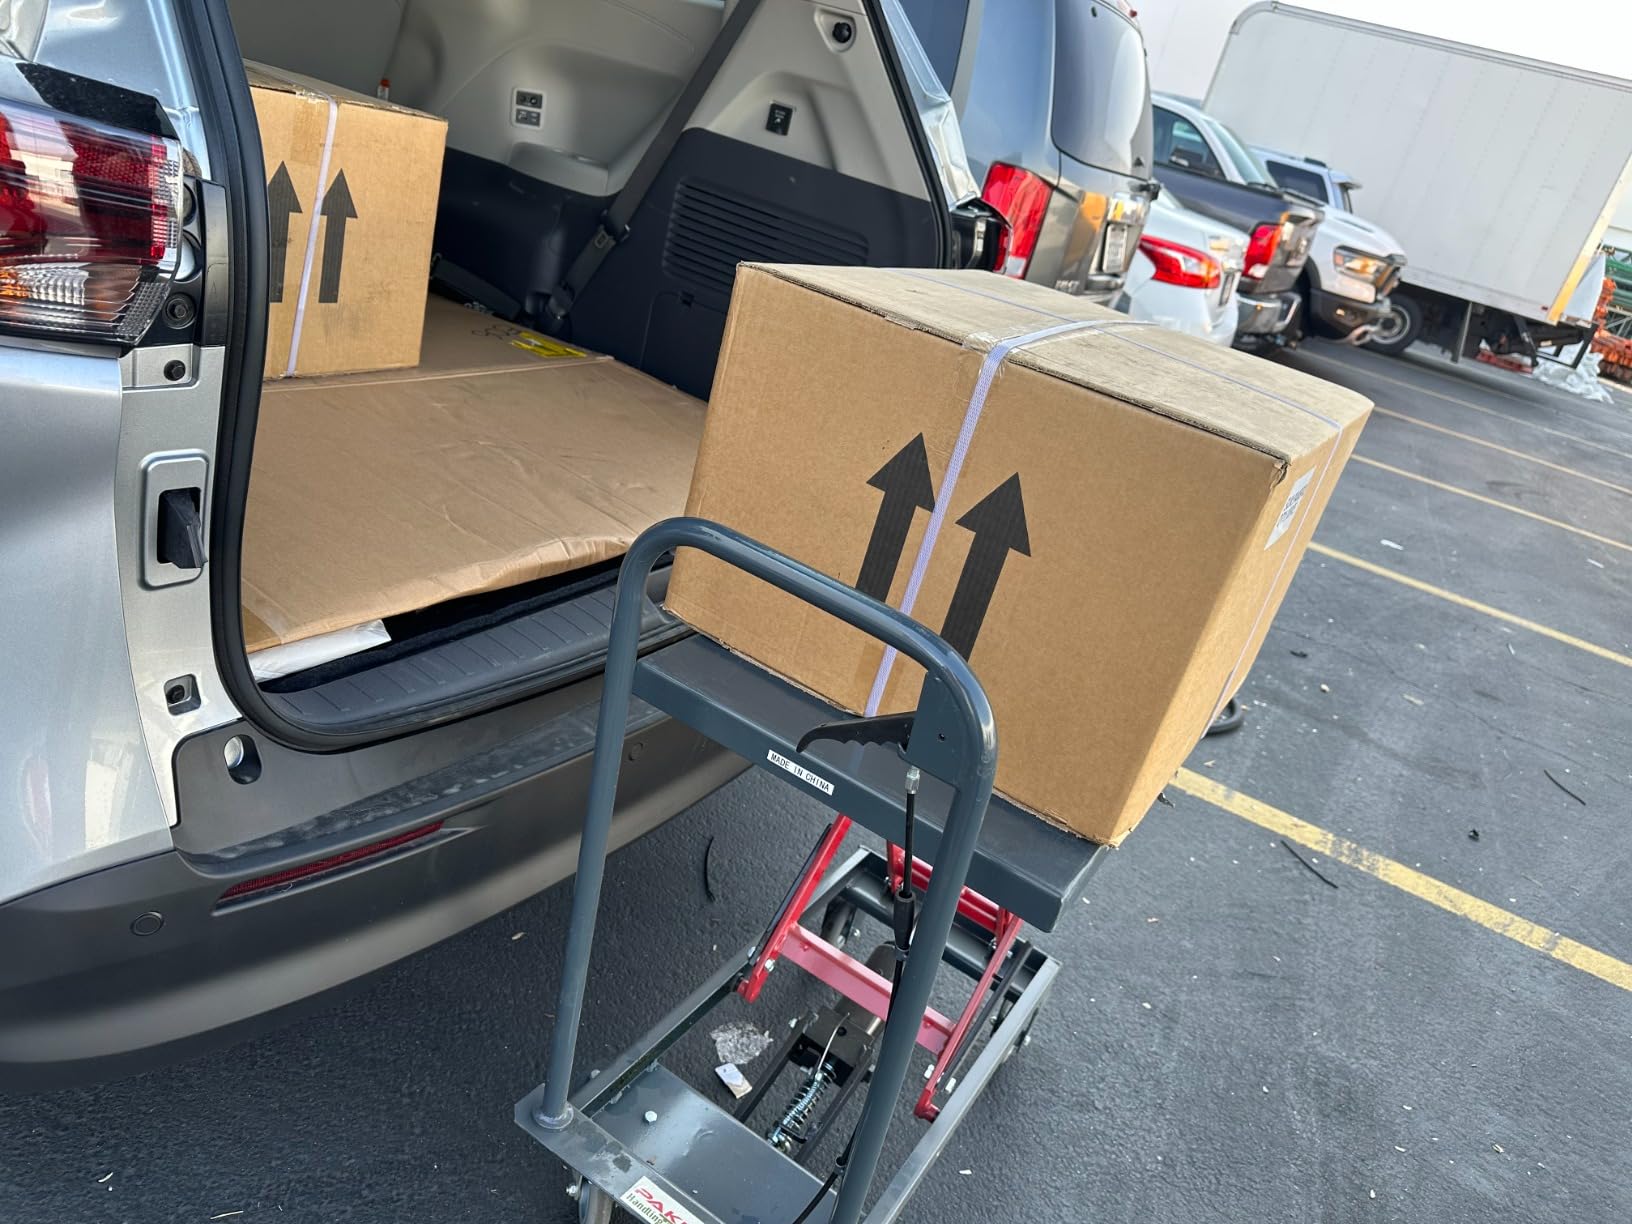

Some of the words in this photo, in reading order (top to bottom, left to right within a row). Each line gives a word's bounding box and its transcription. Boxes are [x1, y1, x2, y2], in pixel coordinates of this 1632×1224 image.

[770, 753, 790, 769] MADE
[793, 766, 804, 777] IN
[805, 773, 829, 791] CHINA
[626, 1193, 663, 1224] Handling
[634, 1187, 688, 1224] PAK
